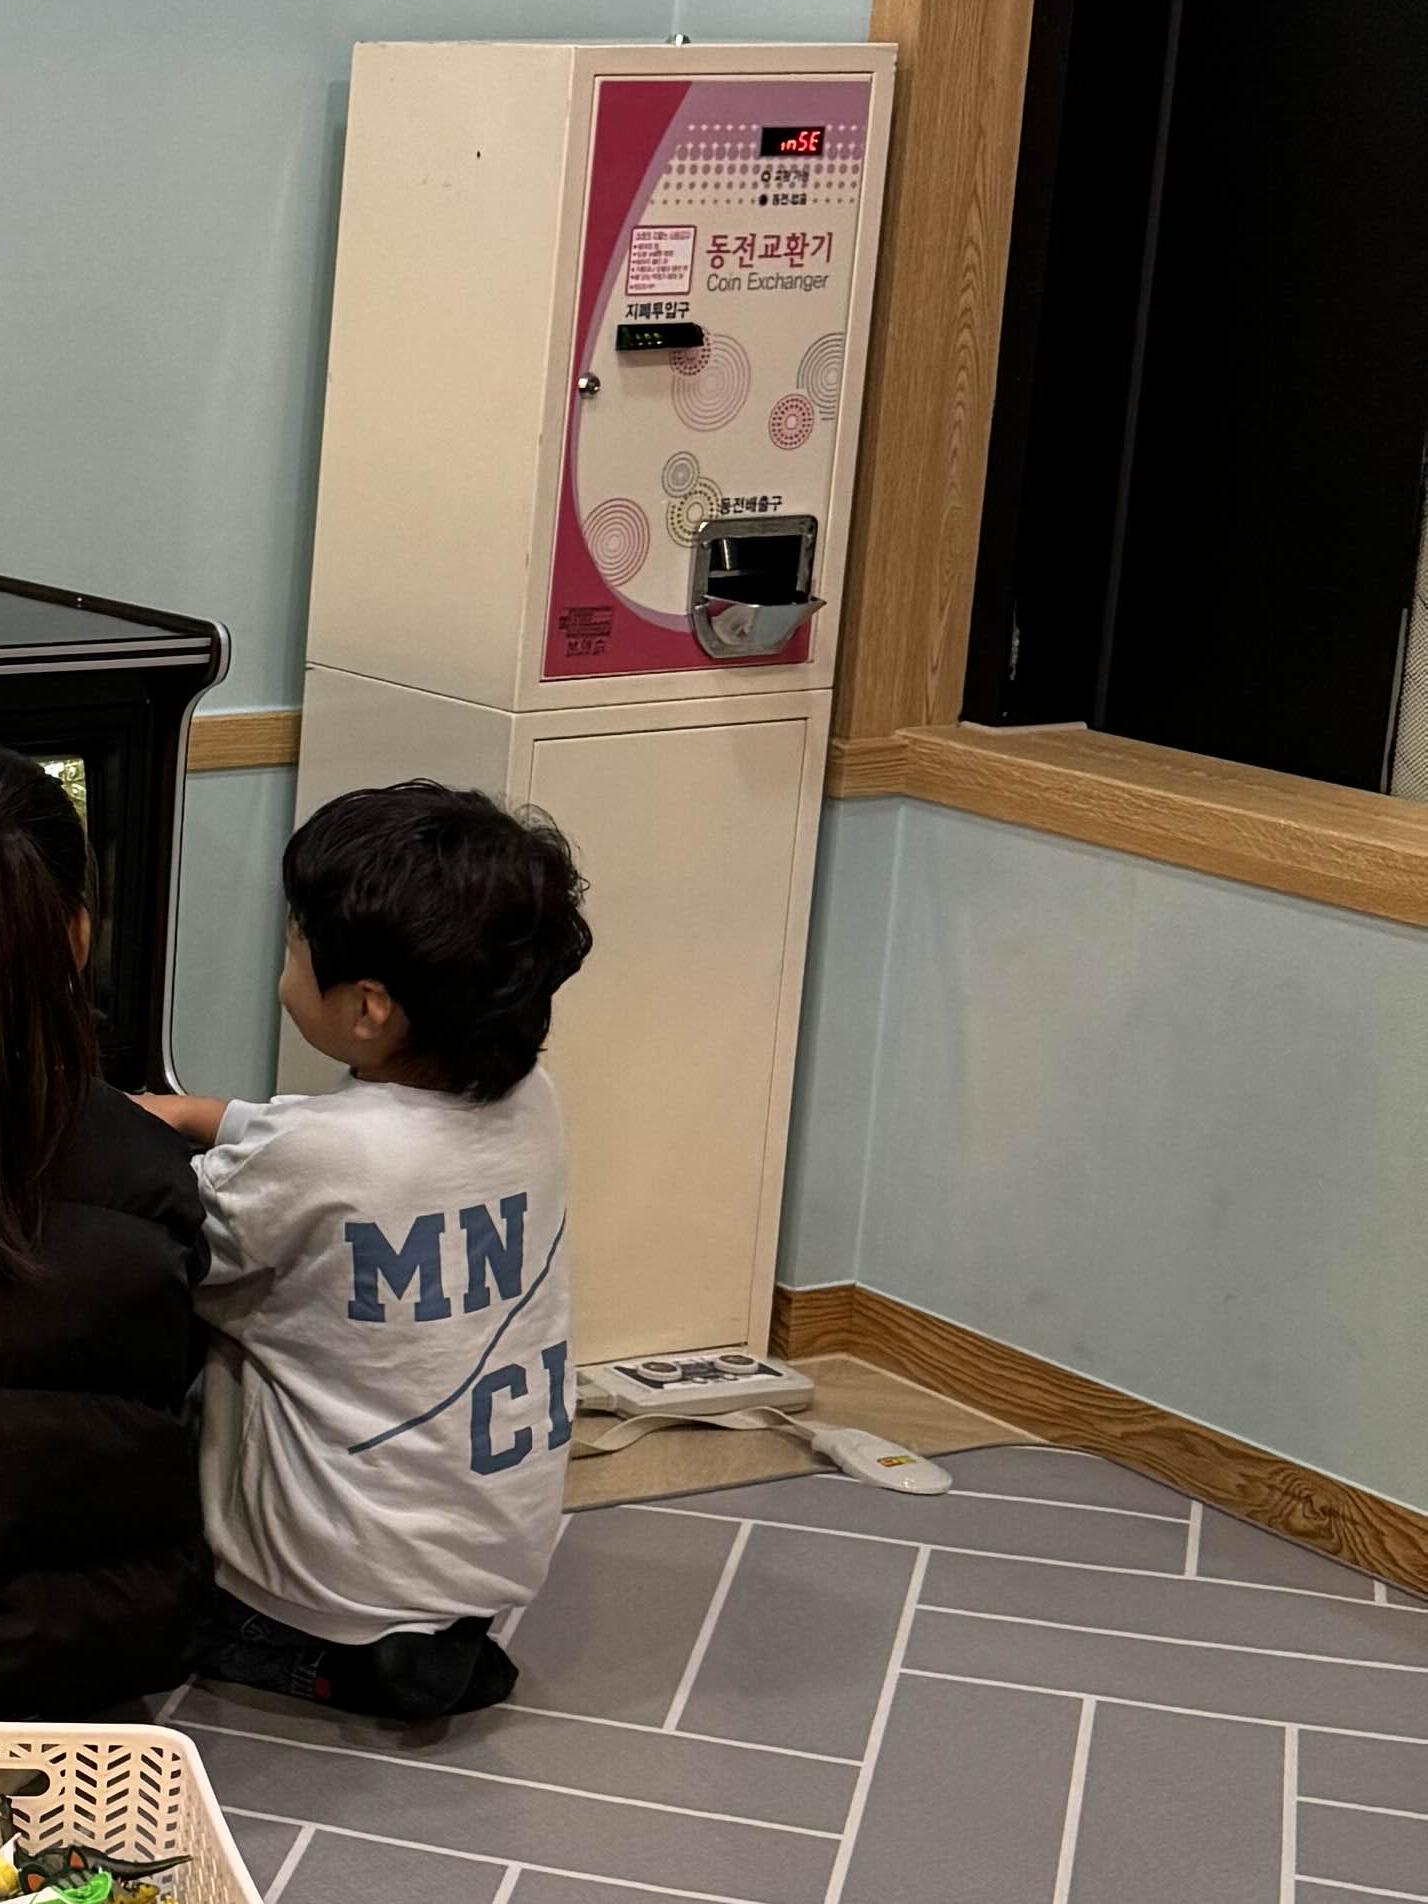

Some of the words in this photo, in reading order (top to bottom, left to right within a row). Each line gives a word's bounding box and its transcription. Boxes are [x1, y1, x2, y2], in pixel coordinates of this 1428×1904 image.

[706, 231, 834, 269] 동전교환기
[706, 273, 742, 292] Coin
[747, 272, 829, 292] Exchanger
[344, 1192, 527, 1322] MN
